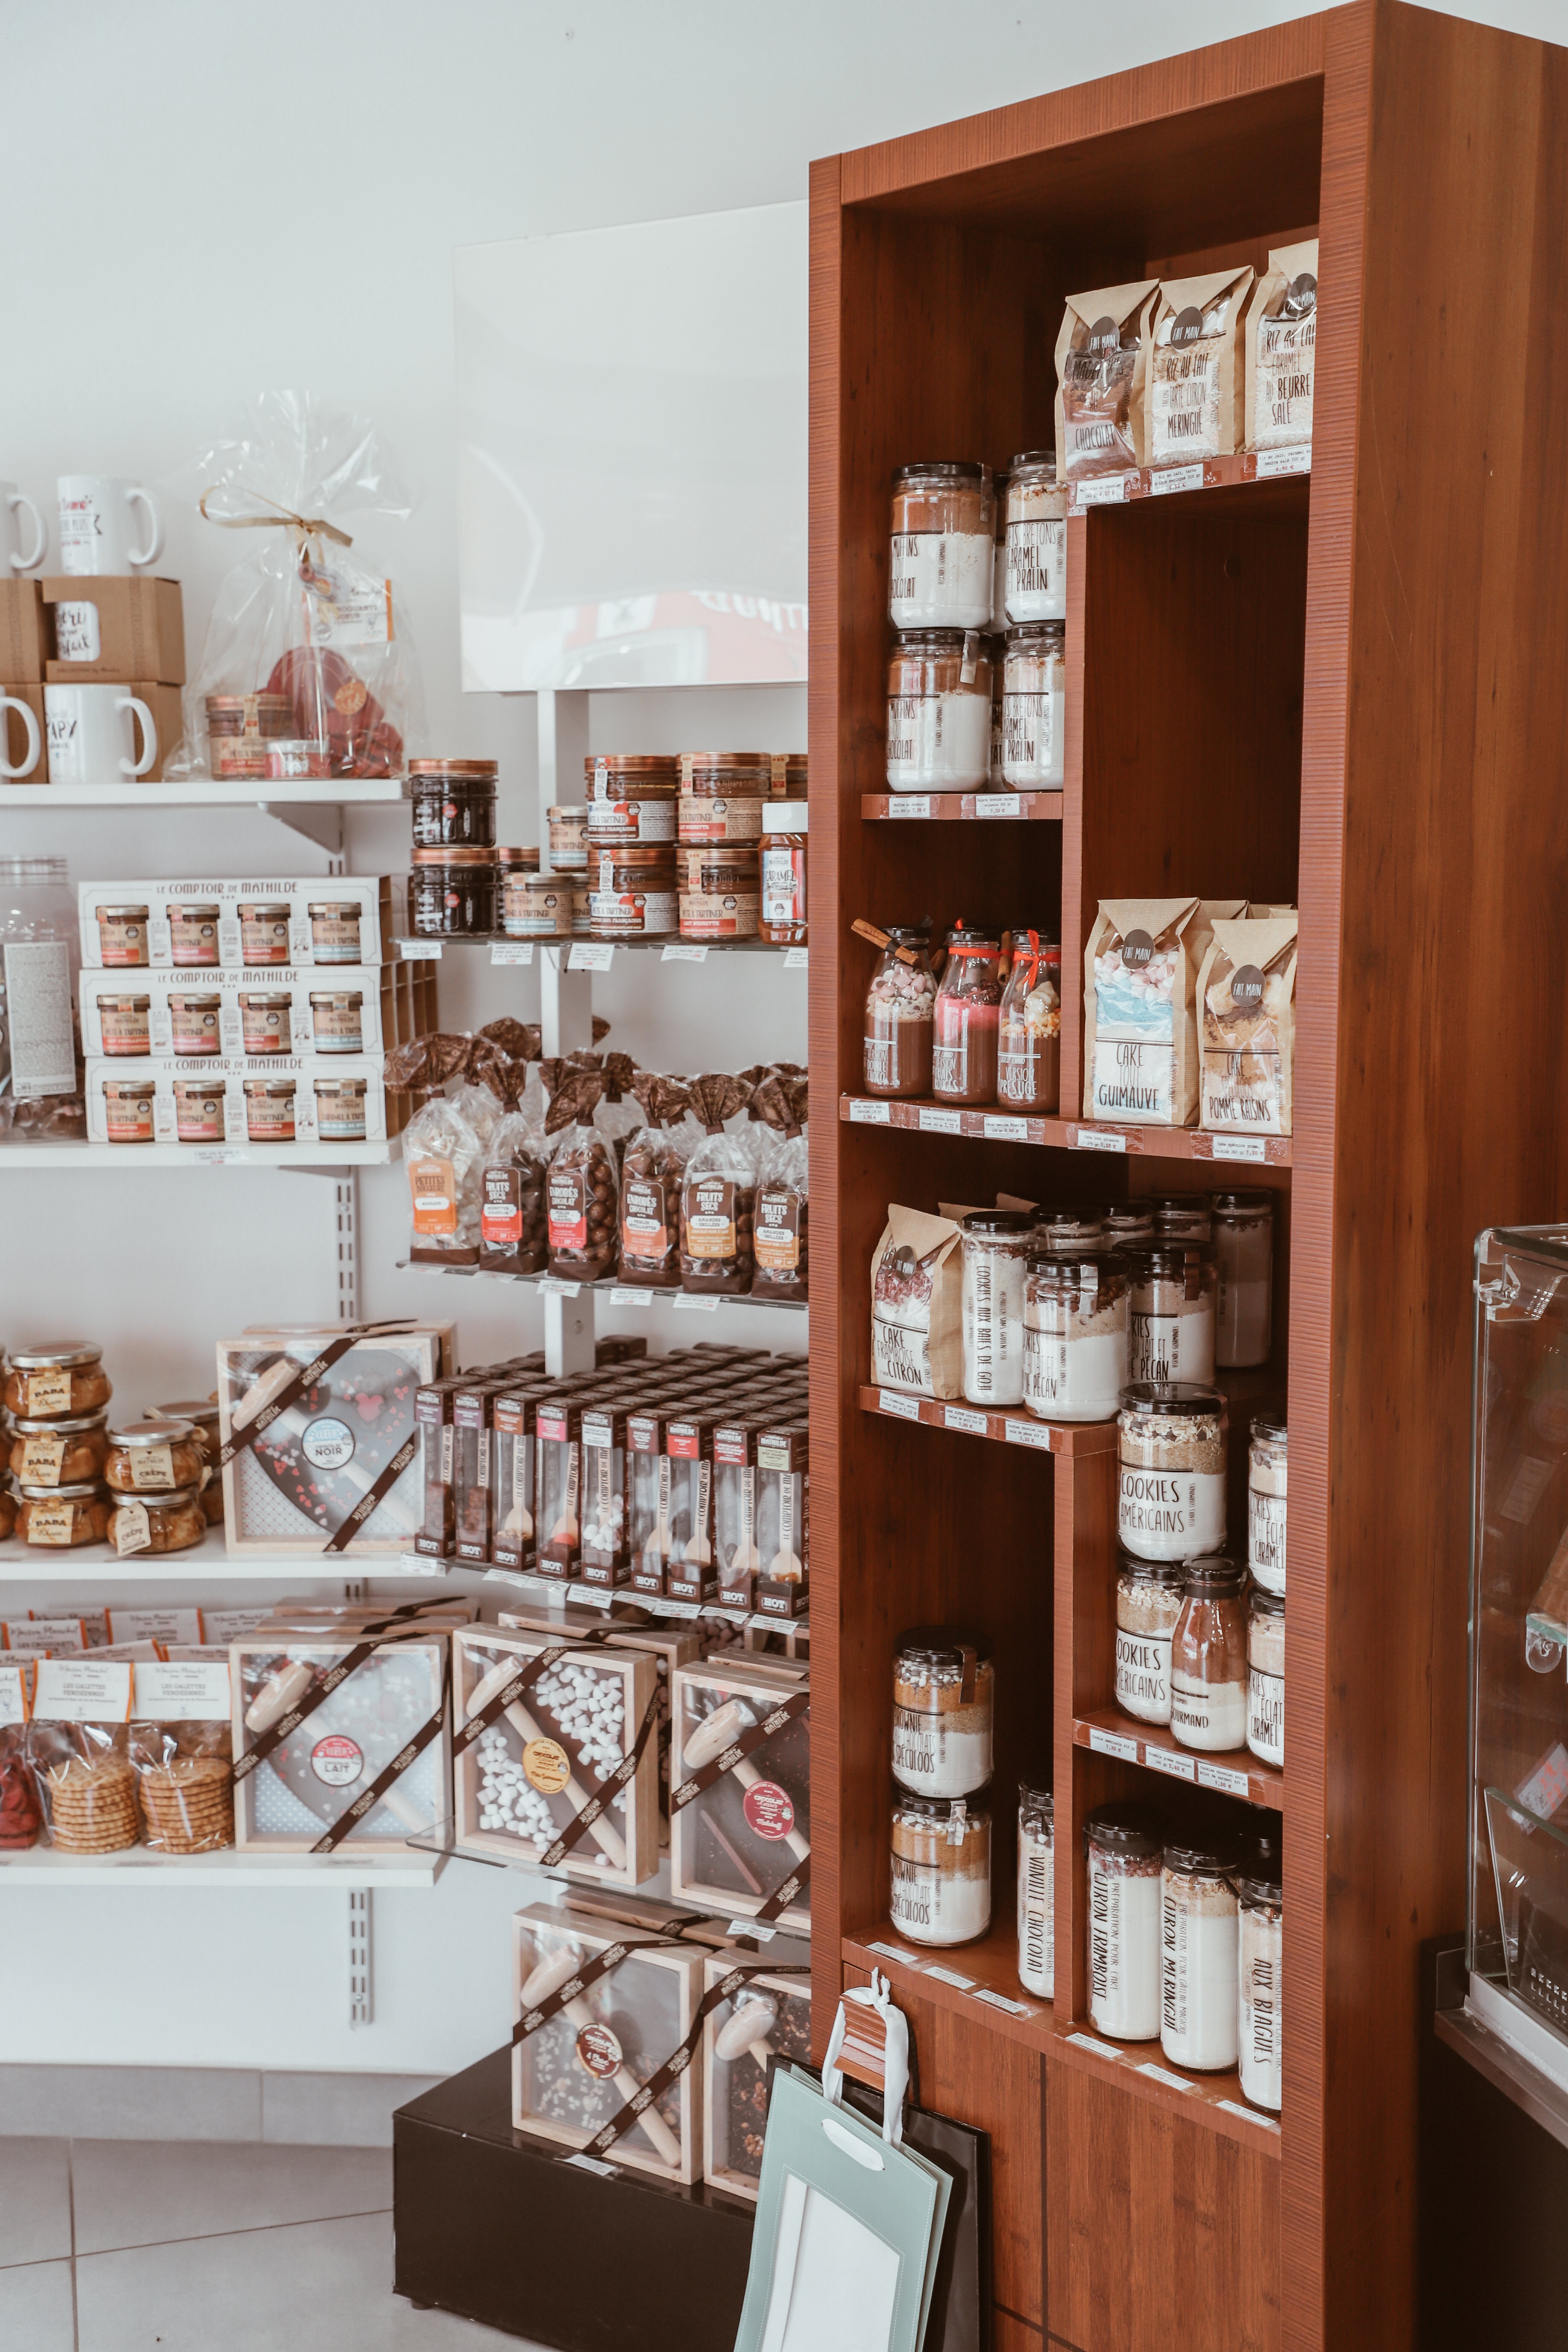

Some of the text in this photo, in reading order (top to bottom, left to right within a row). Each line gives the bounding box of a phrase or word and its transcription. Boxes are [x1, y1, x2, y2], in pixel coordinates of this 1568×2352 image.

[1090, 335, 1116, 350] FAIT MAIN
[1172, 326, 1200, 341] FAIT MAIN
[1267, 324, 1315, 353] RIZ AU LAI
[1167, 353, 1209, 381] RIZ AU LAIT
[1272, 351, 1301, 376] CARAMEL
[1170, 382, 1207, 409] TARTE CITRON
[1266, 374, 1311, 402] AU BEURRE
[1272, 397, 1292, 426] SALÉ
[1168, 407, 1202, 439] MERINGUÉ
[1076, 424, 1116, 450] CHOCOLAT
[1023, 523, 1056, 546] BRETONS
[893, 536, 918, 557] MUFFINS
[1008, 545, 1040, 570] CARAMEL
[1017, 568, 1047, 591] PRALIN
[890, 700, 915, 720] MUFFINS
[1013, 696, 1043, 717] BRETONS
[1008, 740, 1034, 762] PRALIN
[765, 870, 796, 882] CARAMEL
[169, 883, 224, 895] COMPTOIR
[241, 881, 298, 894] MATHILDE
[1123, 947, 1151, 961] FAIT MAIN
[170, 972, 225, 984] COMPTOIR
[242, 970, 299, 983] MATHILDE
[1233, 983, 1262, 997] FAIT MAIN
[176, 1059, 230, 1070] COMPTOIR
[247, 1058, 304, 1070] MATHILDE
[935, 1058, 956, 1070] VERSION
[1116, 1044, 1144, 1067] CAKE
[1227, 1054, 1245, 1077] CAKE
[867, 1060, 886, 1072] DOUBLE
[935, 1068, 953, 1080] FRUITS
[1005, 1066, 1035, 1082] VERSION
[1119, 1065, 1140, 1087] TOUT
[867, 1071, 886, 1083] CHOCO
[934, 1078, 960, 1093] ROUGES
[1000, 1080, 1038, 1096] PRESTIGE
[1098, 1084, 1159, 1111] GUIMAUVE
[1210, 1096, 1271, 1121] POMME RAISINS
[415, 1176, 445, 1185] PETITES
[485, 1181, 510, 1192] FRUITS
[489, 1191, 506, 1200] SECS
[696, 1191, 723, 1202] FRUITS
[700, 1201, 718, 1212] SECS
[761, 1204, 787, 1215] FRUITS
[765, 1213, 782, 1225] SECS
[882, 1325, 906, 1349] CAKE
[976, 1266, 992, 1391] COOKIES AUX BAIES DE GOJI
[877, 1340, 915, 1369] FRAMBOISE
[1158, 1339, 1165, 1359] ET
[888, 1360, 922, 1386] CITRON
[1141, 1356, 1169, 1381] PÉCAN
[1034, 1373, 1057, 1400] PÉCAN
[315, 1447, 343, 1456] NOIR
[1121, 1473, 1180, 1503] COOKIES
[1119, 1503, 1185, 1533] AMÉRICAINS
[496, 1551, 517, 1562] HOT
[541, 1559, 562, 1570] HOT
[1255, 1540, 1284, 1569] CARAMEL
[586, 1566, 607, 1578] HOT
[636, 1576, 657, 1588] HOT
[672, 1582, 694, 1593] HOT
[722, 1590, 744, 1602] HOT
[763, 1597, 786, 1609] HOT
[1116, 1638, 1161, 1670] OOKIES
[1251, 1716, 1278, 1746] CARAMEL
[325, 1764, 349, 1773] LAIT
[1175, 1759, 1191, 1769] chocolat
[1027, 1857, 1045, 1975] VANILLE CHOCOLAT
[1093, 1872, 1109, 2001] CITRON FRAMBOISE
[1110, 1944, 1119, 1966] POUR
[1164, 1896, 1178, 2034] CITRON MERINGUÉ
[1110, 1971, 1118, 1991] CAKE
[1254, 1958, 1273, 2066] AUX BLAGUES
